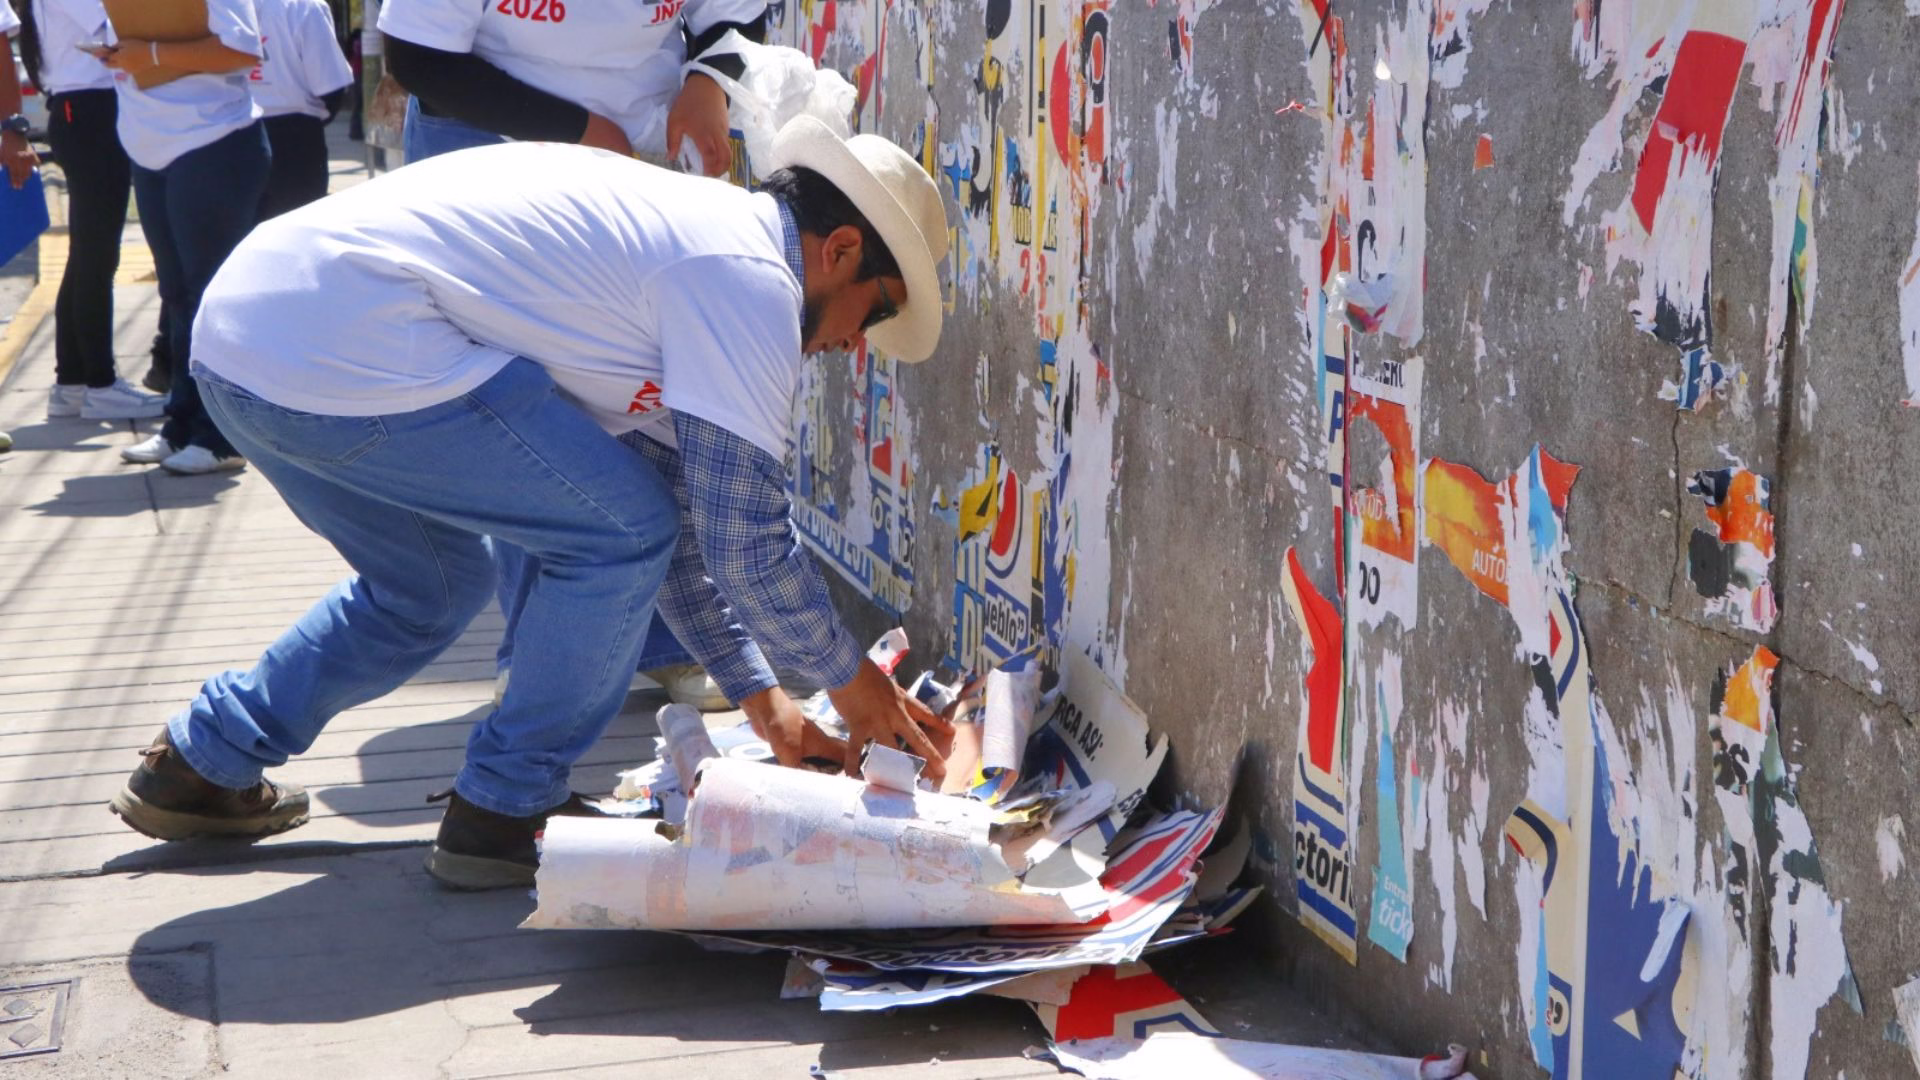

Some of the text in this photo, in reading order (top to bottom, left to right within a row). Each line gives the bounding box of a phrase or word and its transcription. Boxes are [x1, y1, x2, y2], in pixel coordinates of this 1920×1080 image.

[496, 0, 566, 23] 2026
[1471, 549, 1509, 584] AUTO
[1295, 830, 1354, 909] ctori
[1379, 898, 1411, 939] tick
